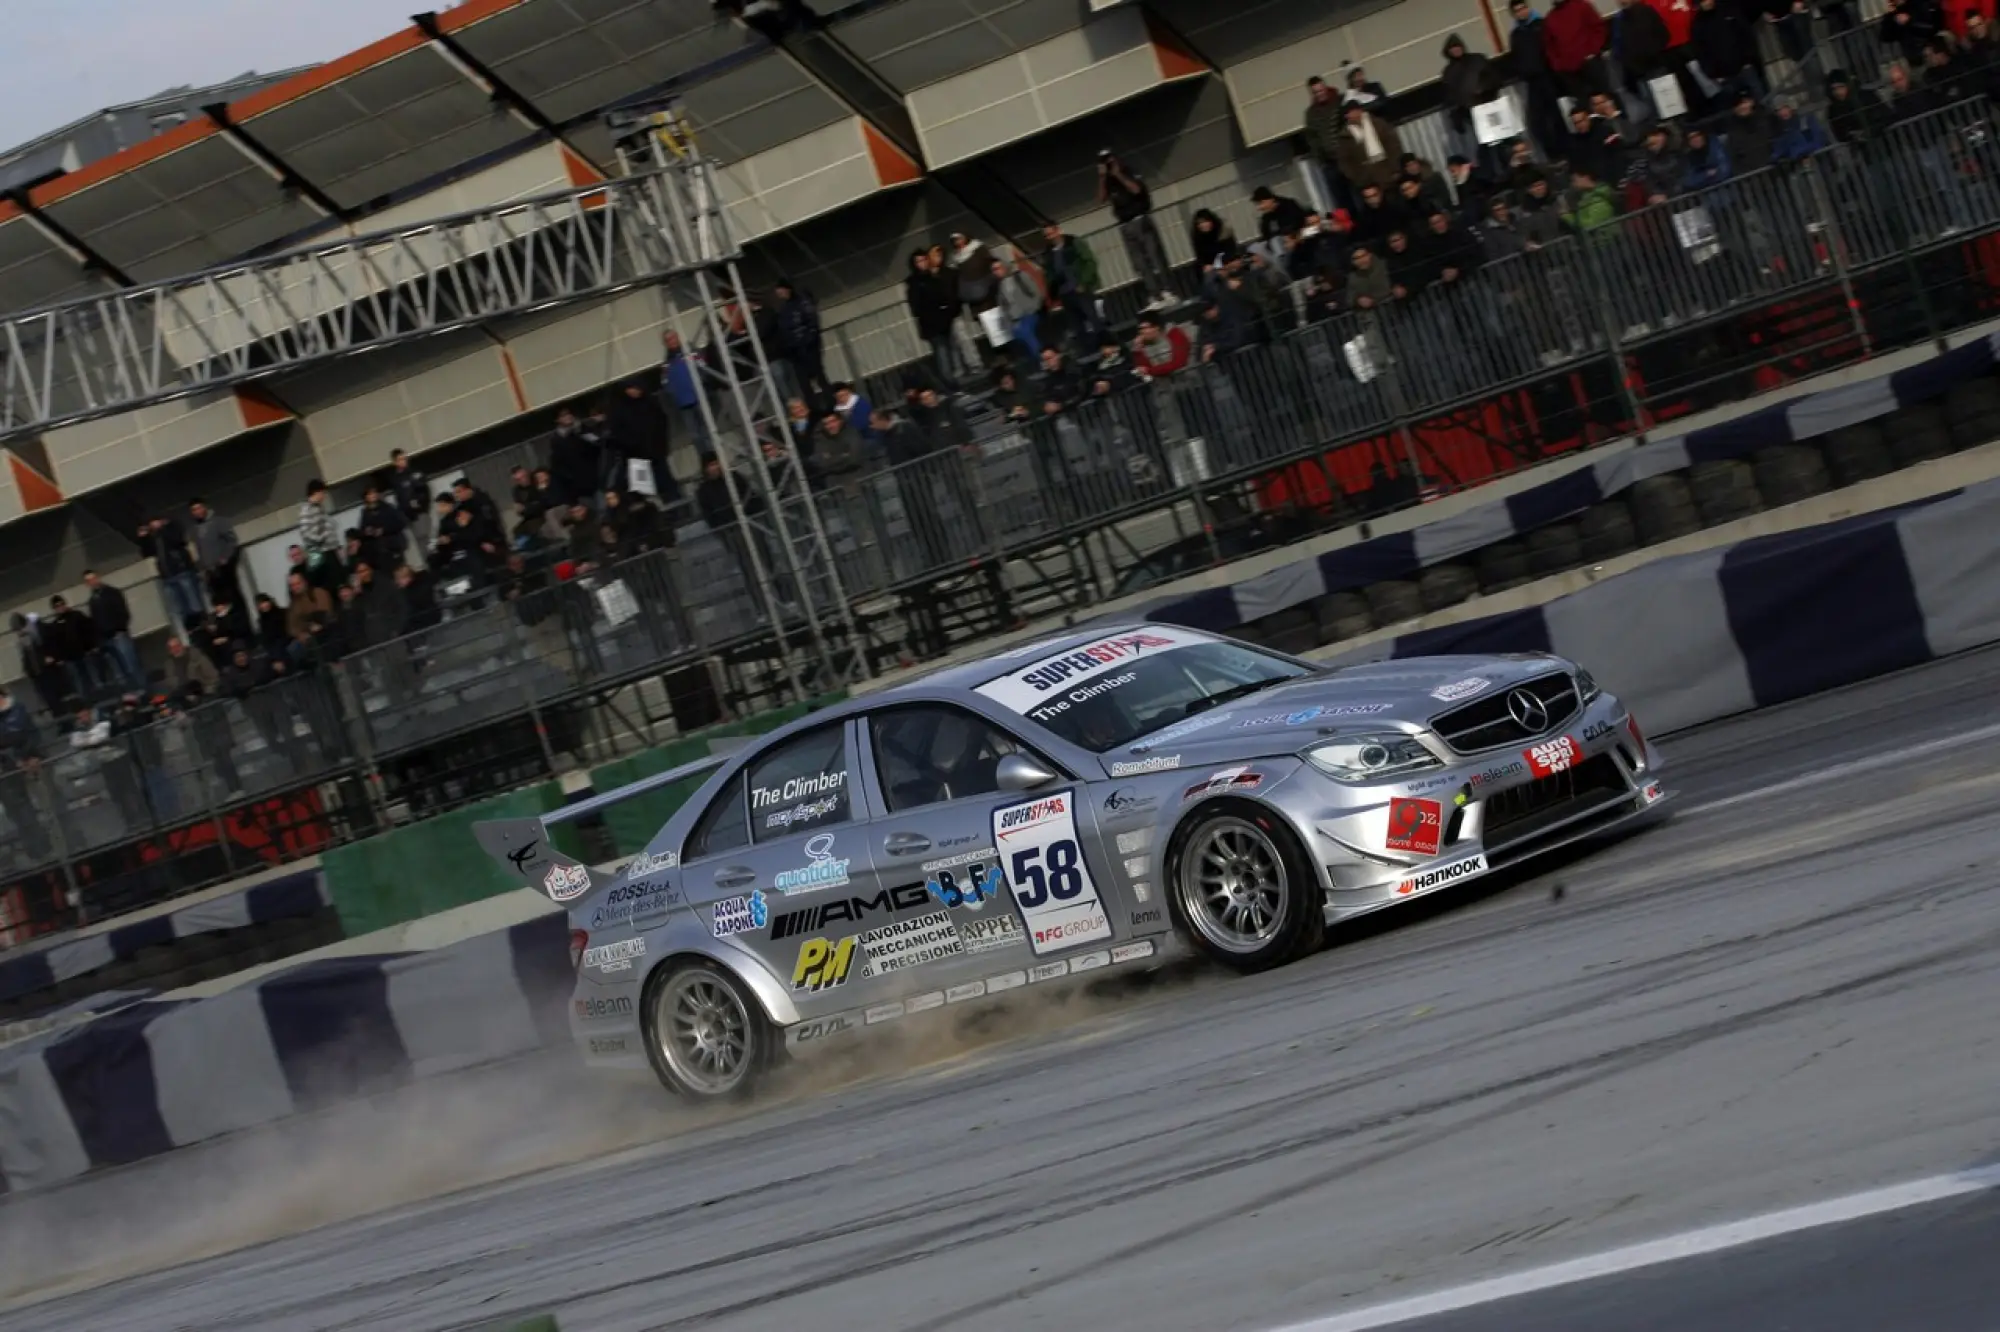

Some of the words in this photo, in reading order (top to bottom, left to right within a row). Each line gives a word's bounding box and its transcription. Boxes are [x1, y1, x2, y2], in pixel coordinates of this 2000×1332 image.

[1031, 701, 1071, 721] The
[1069, 671, 1137, 702] Climber
[1531, 737, 1569, 759] AUTO
[751, 787, 780, 809] The
[783, 770, 848, 800] Climber
[1001, 798, 1065, 828] SUPERSTARS
[1012, 839, 1082, 908] 58
[715, 898, 746, 918] ACQUA
[816, 880, 930, 929] AMG
[716, 914, 755, 935] SAPONE
[858, 911, 949, 944] LAVORAZIONI
[862, 966, 874, 977] di
[880, 941, 963, 972] PRECISIONE
[866, 926, 957, 959] MECCANICHE
